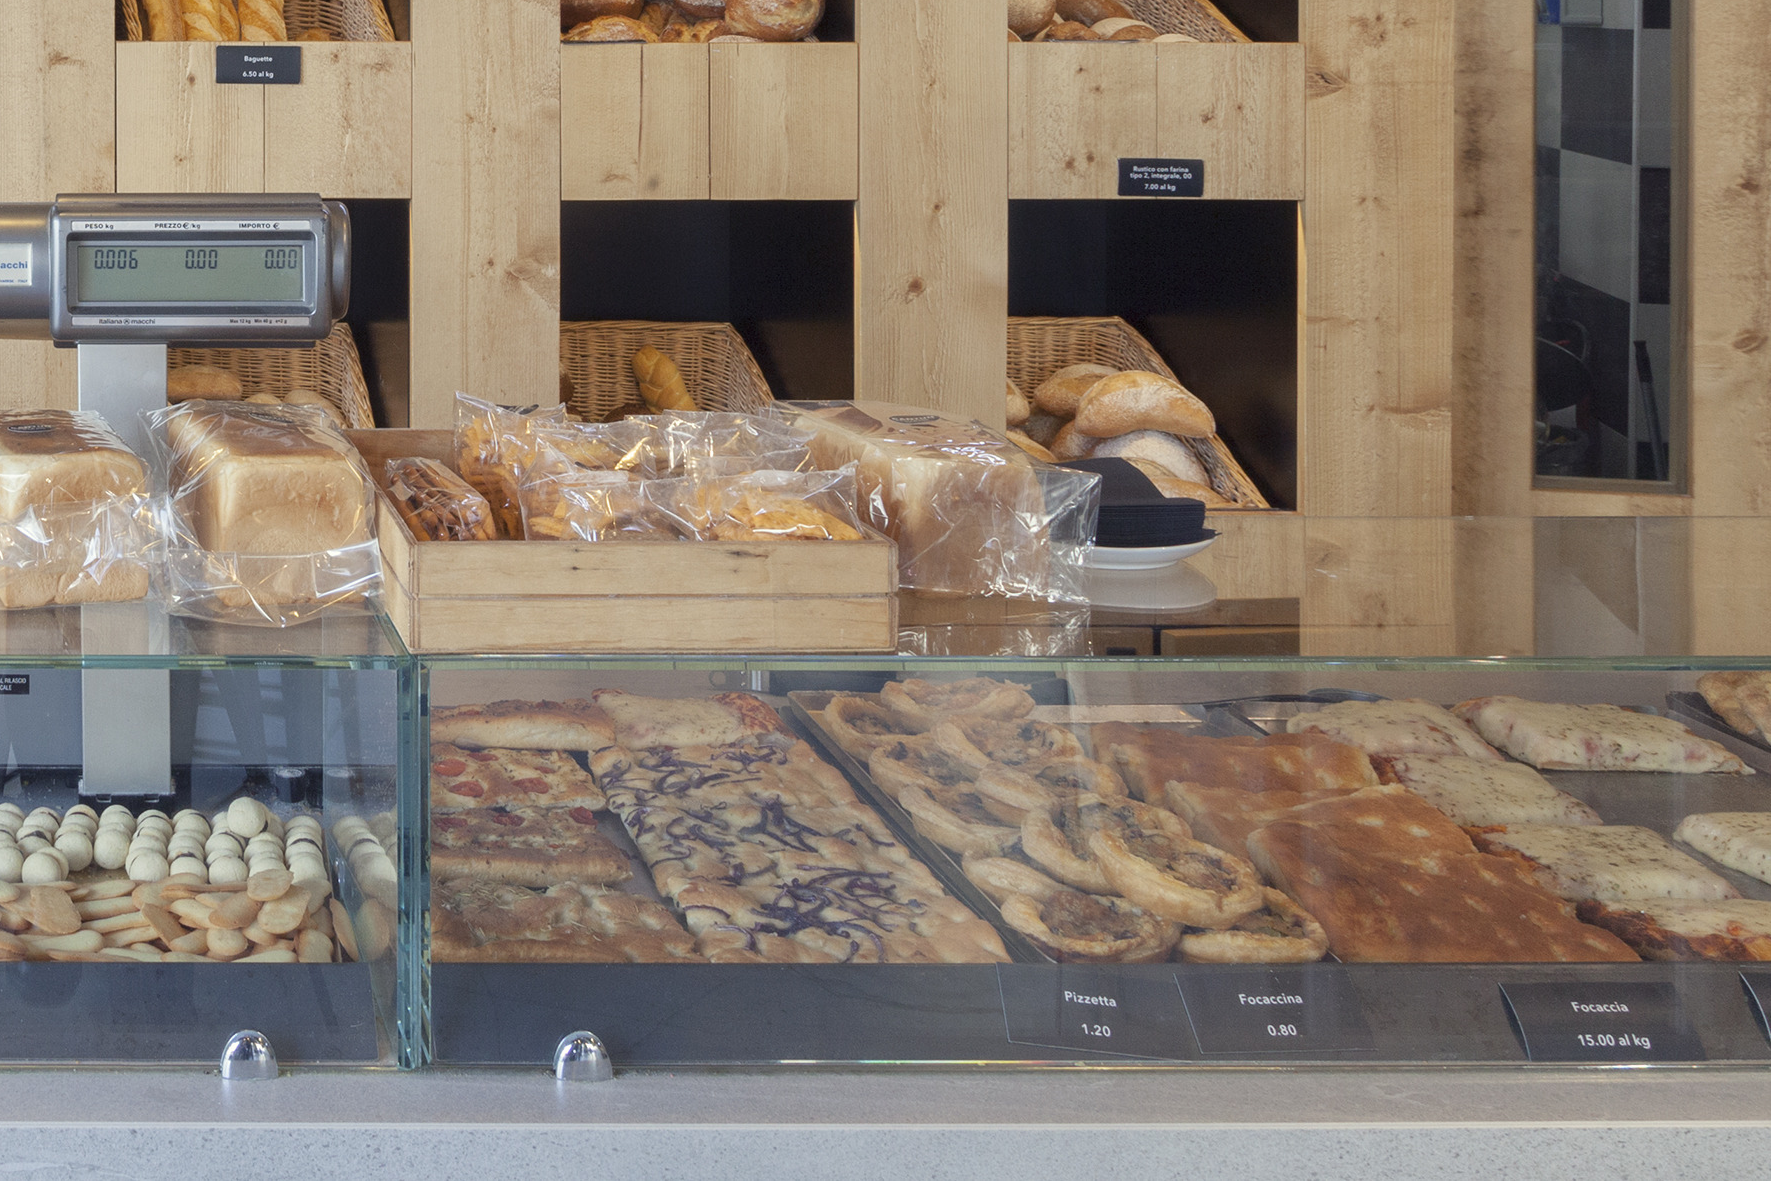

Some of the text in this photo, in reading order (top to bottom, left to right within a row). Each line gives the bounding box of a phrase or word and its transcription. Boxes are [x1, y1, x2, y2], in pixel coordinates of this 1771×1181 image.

[243, 55, 273, 63] Baguette
[1167, 184, 1176, 192] kg
[185, 249, 218, 269] 0.00
[264, 249, 297, 269] 0.00
[1064, 990, 1117, 1007] Pizzetta
[1238, 993, 1304, 1005] Focaccina
[1570, 1001, 1629, 1013] Focaccia
[1081, 1022, 1112, 1037] 1.20
[1266, 1023, 1298, 1037] 0.80
[1577, 1033, 1651, 1049] 15.00 al kg
